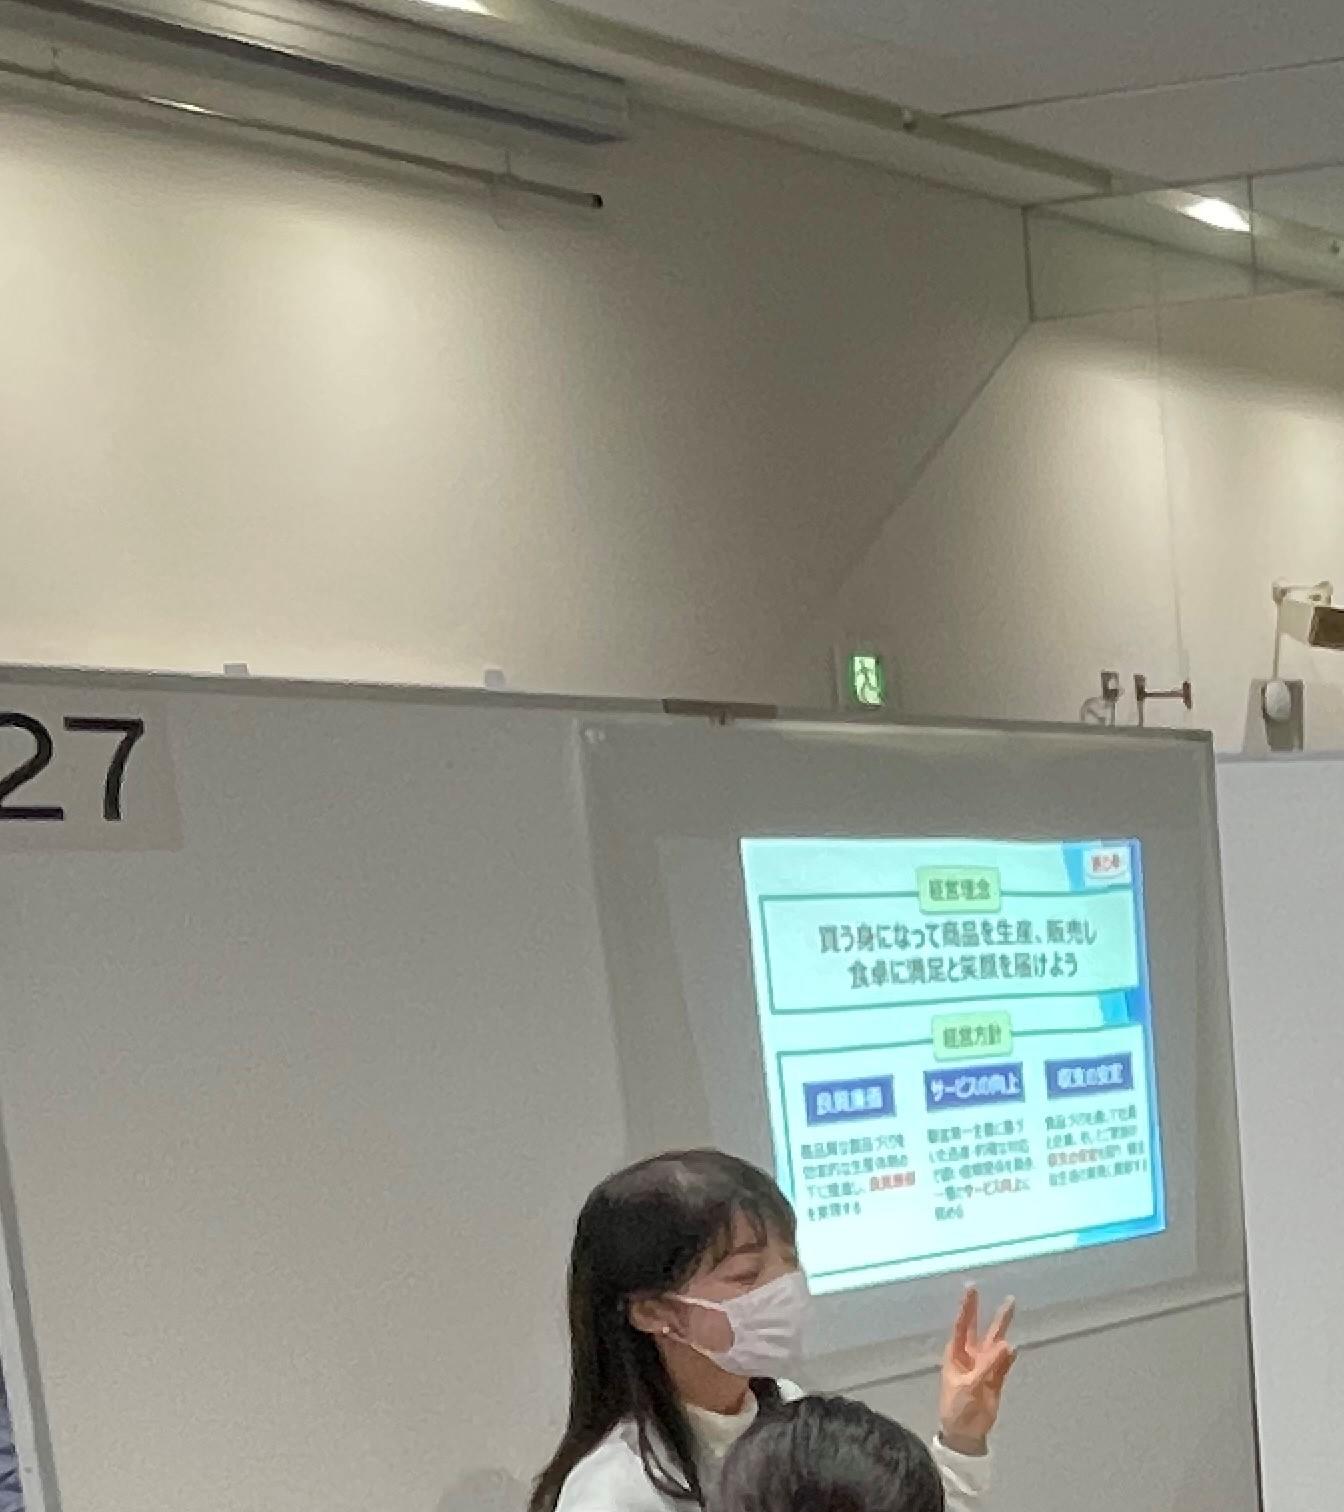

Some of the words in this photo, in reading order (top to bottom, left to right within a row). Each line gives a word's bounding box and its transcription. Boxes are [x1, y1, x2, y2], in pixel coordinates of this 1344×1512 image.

[0, 712, 144, 821] 27
[818, 918, 1098, 954] 買う身になって商品を生産、販売し
[847, 951, 1079, 989] 食卓に満足と笑顔を届けよう
